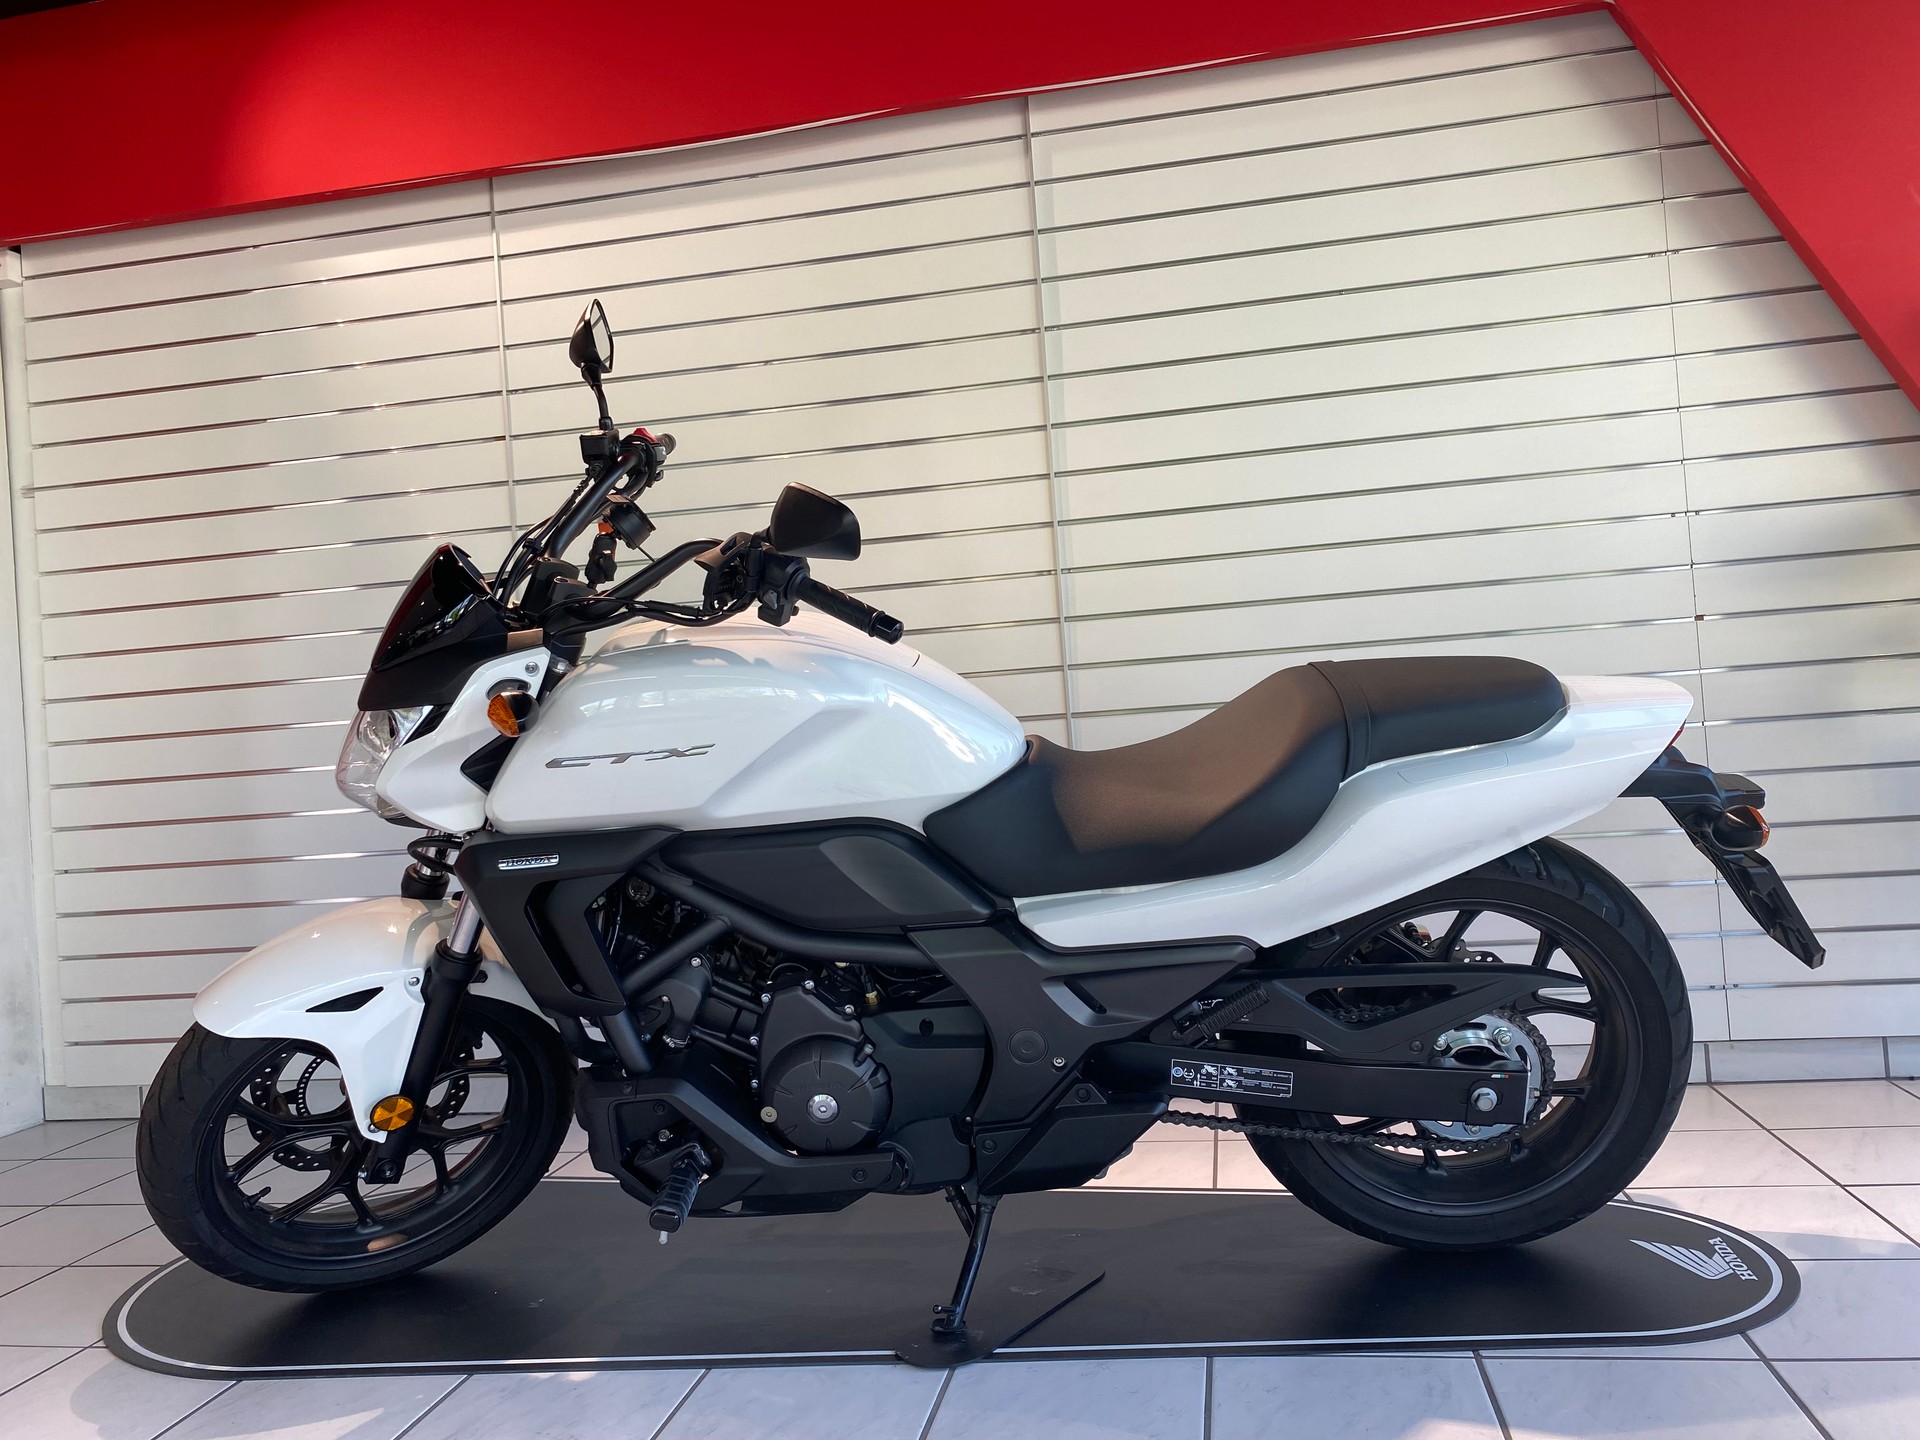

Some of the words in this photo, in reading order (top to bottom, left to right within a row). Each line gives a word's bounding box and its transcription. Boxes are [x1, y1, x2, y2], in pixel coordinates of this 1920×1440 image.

[545, 743, 716, 769] CTX
[505, 856, 551, 867] HONDA
[1708, 1236, 1759, 1281] HONDA
